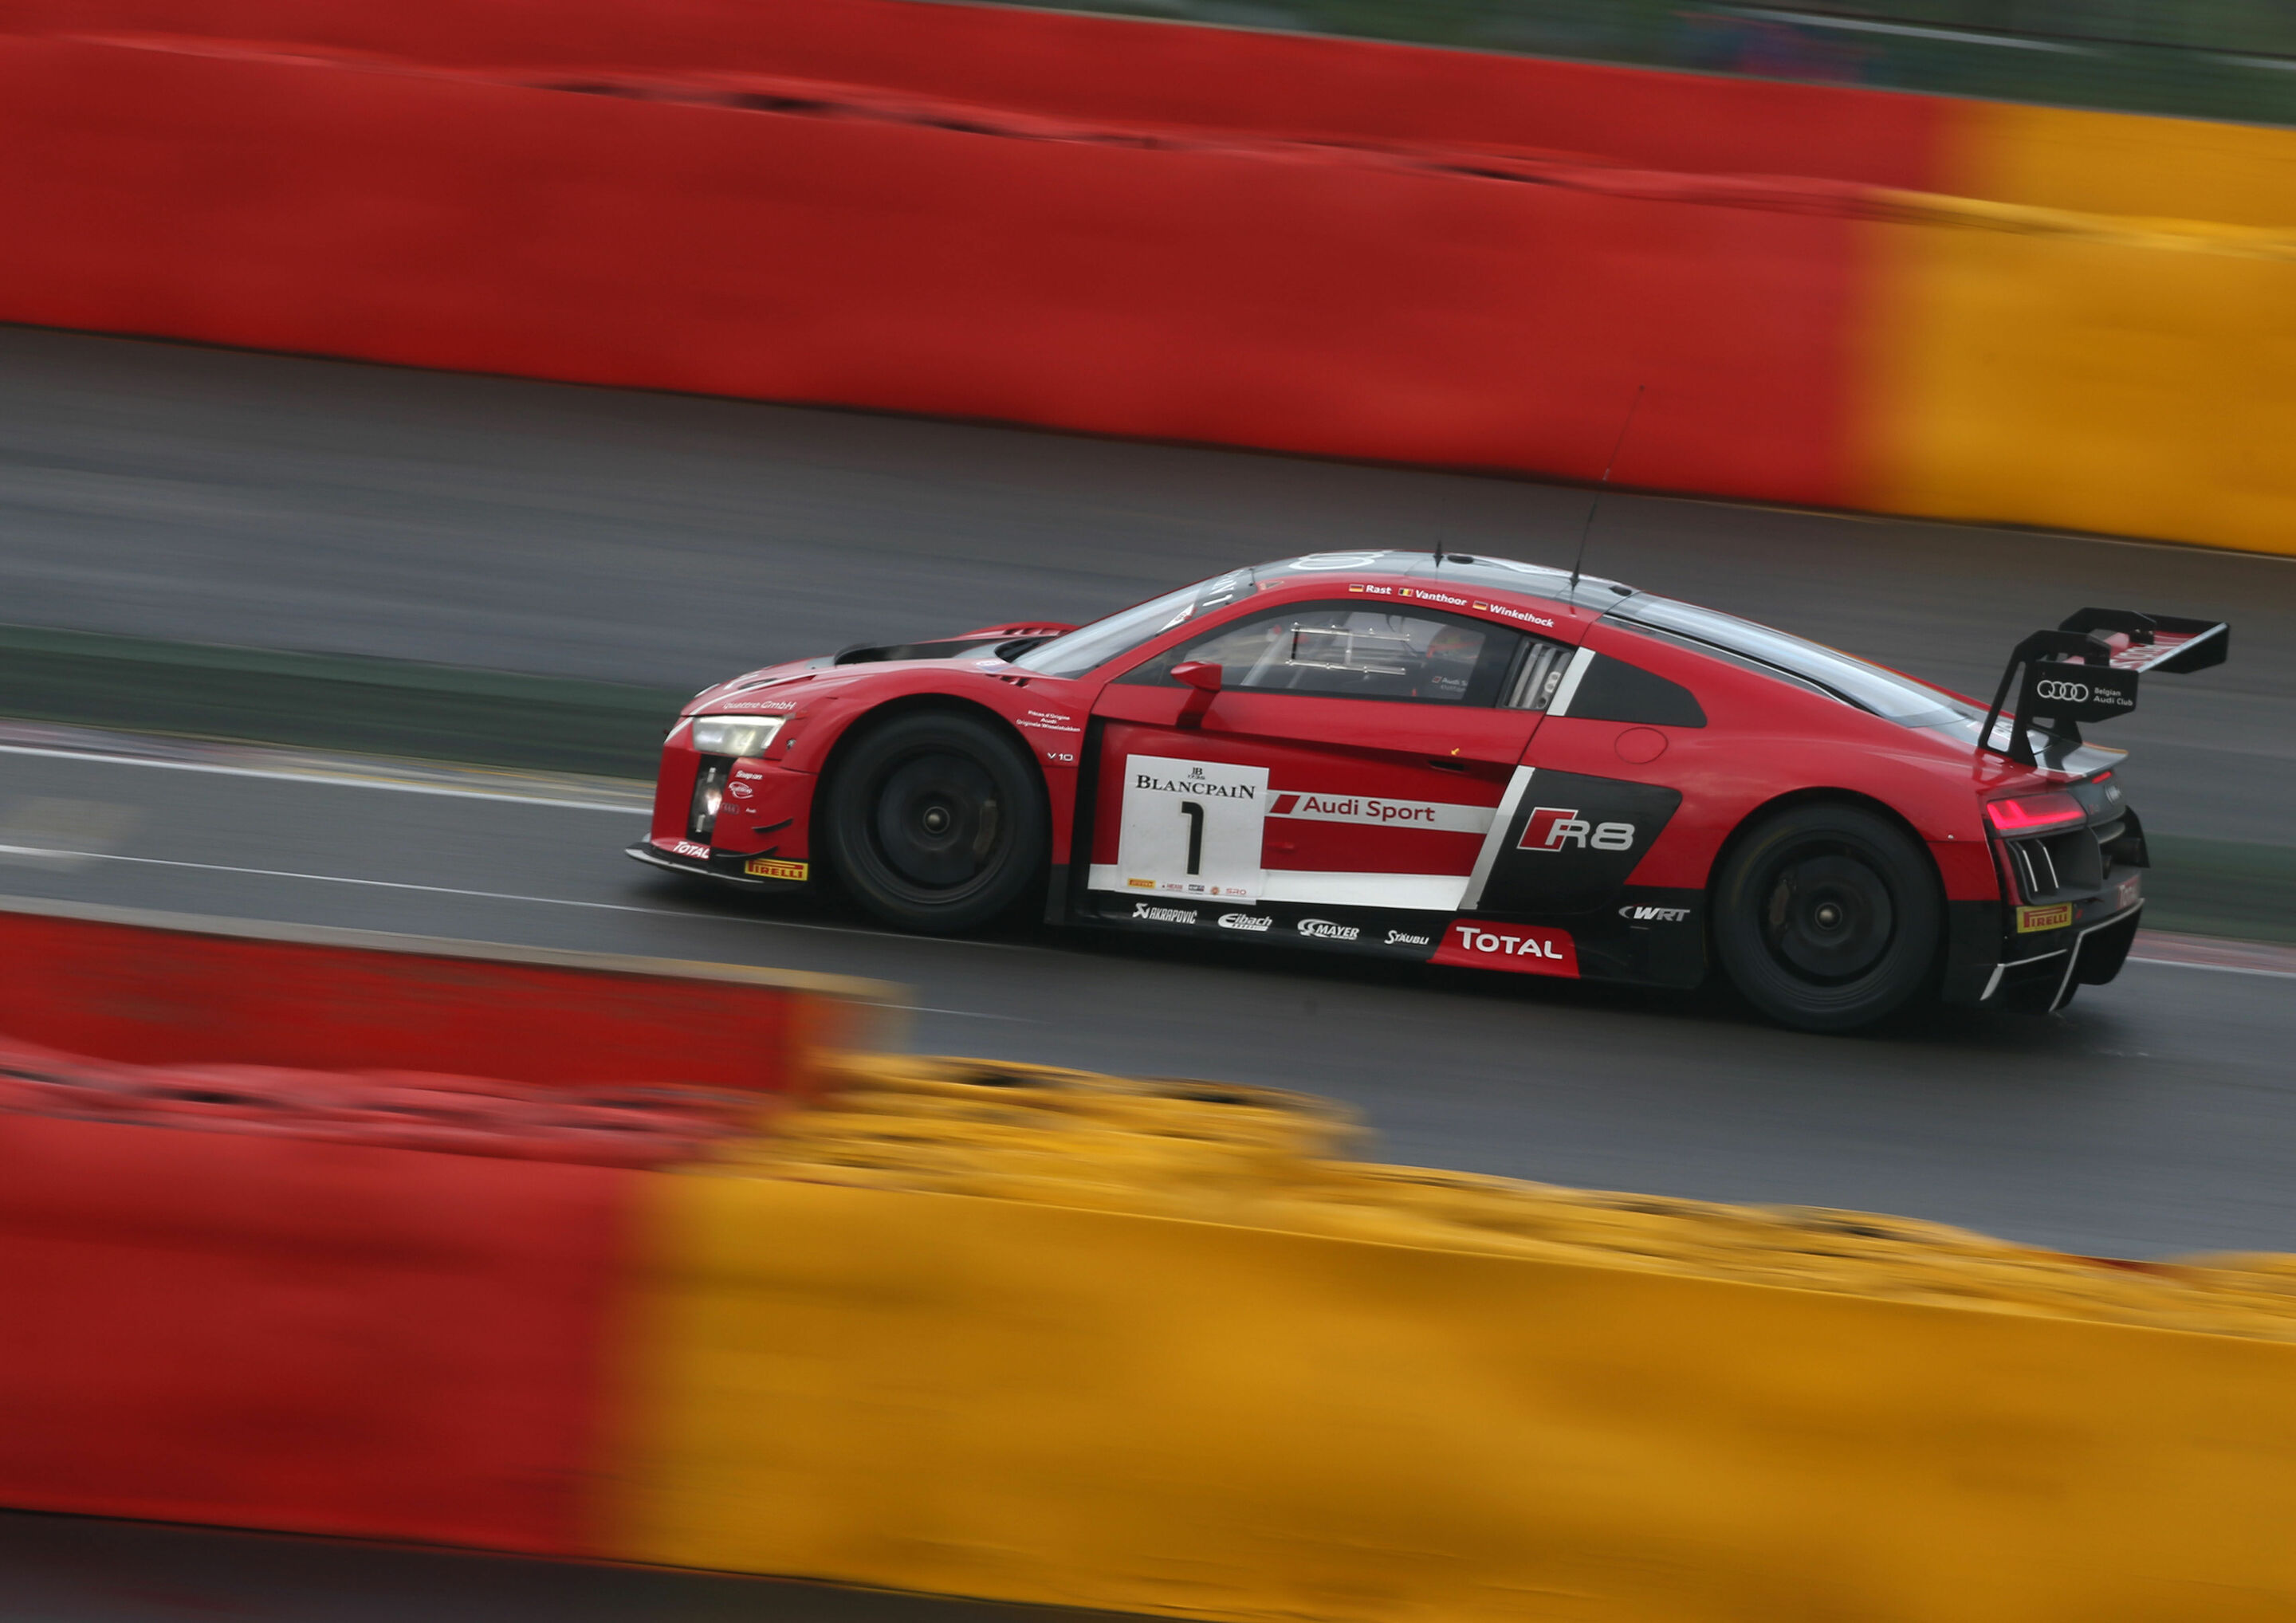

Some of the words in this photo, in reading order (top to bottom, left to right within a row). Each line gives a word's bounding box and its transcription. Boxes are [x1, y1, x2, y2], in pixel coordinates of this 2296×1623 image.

[1366, 584, 1392, 595] Rast
[1415, 589, 1467, 606] Vanthoor
[1489, 603, 1554, 627] Winkelhock
[2094, 686, 2121, 697] Belgian
[761, 701, 796, 710] GmbH
[2094, 695, 2115, 705] Audi
[2117, 698, 2133, 707] Club
[1136, 775, 1256, 800] BLANCPAIN
[1303, 796, 1359, 815] Audi
[1366, 800, 1436, 823] Sport
[1181, 800, 1205, 875] 1
[1543, 818, 1636, 851] R8
[673, 841, 710, 859] TOTAL
[748, 859, 804, 879] PIRELLI
[1217, 913, 1273, 931] Eibach
[1634, 906, 1691, 922] WRT
[2023, 906, 2069, 928] PIRELLI
[1315, 924, 1360, 939] MAYER
[1456, 925, 1563, 960] TOTAL
